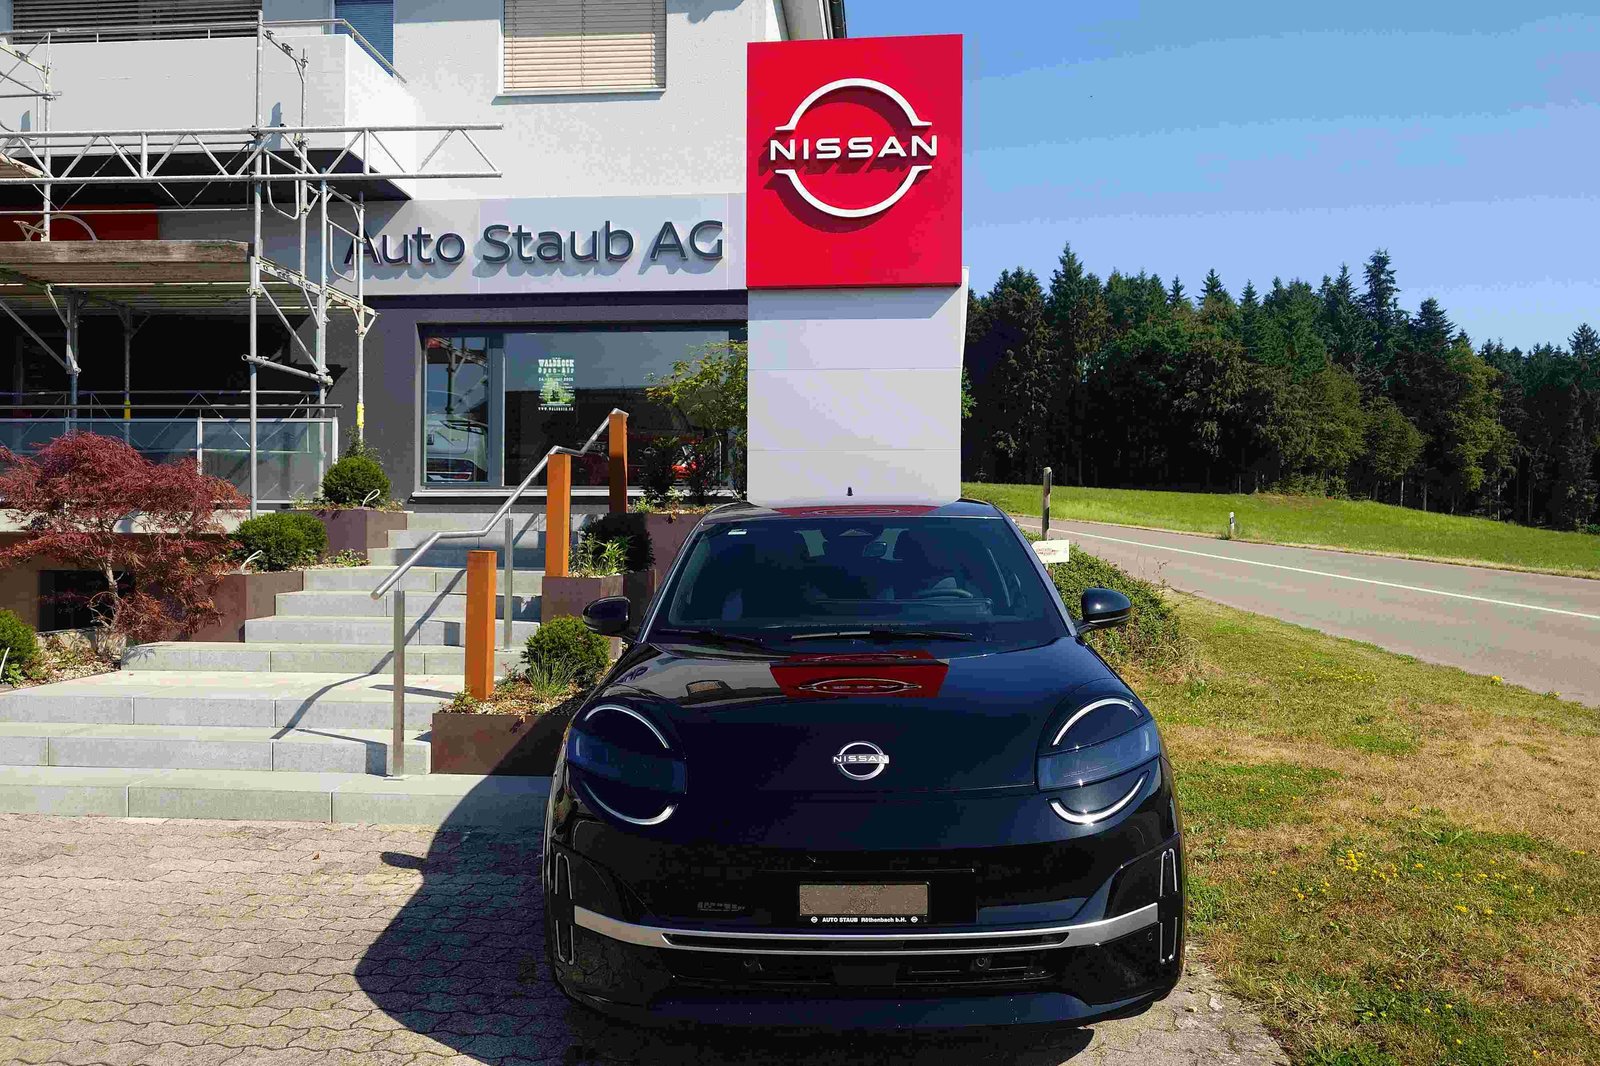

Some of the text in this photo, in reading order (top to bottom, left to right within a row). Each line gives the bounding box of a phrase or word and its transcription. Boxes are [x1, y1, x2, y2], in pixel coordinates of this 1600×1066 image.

[770, 135, 938, 161] NISSAN
[344, 220, 723, 264] Auto Staub AG
[833, 755, 888, 763] NISSAN
